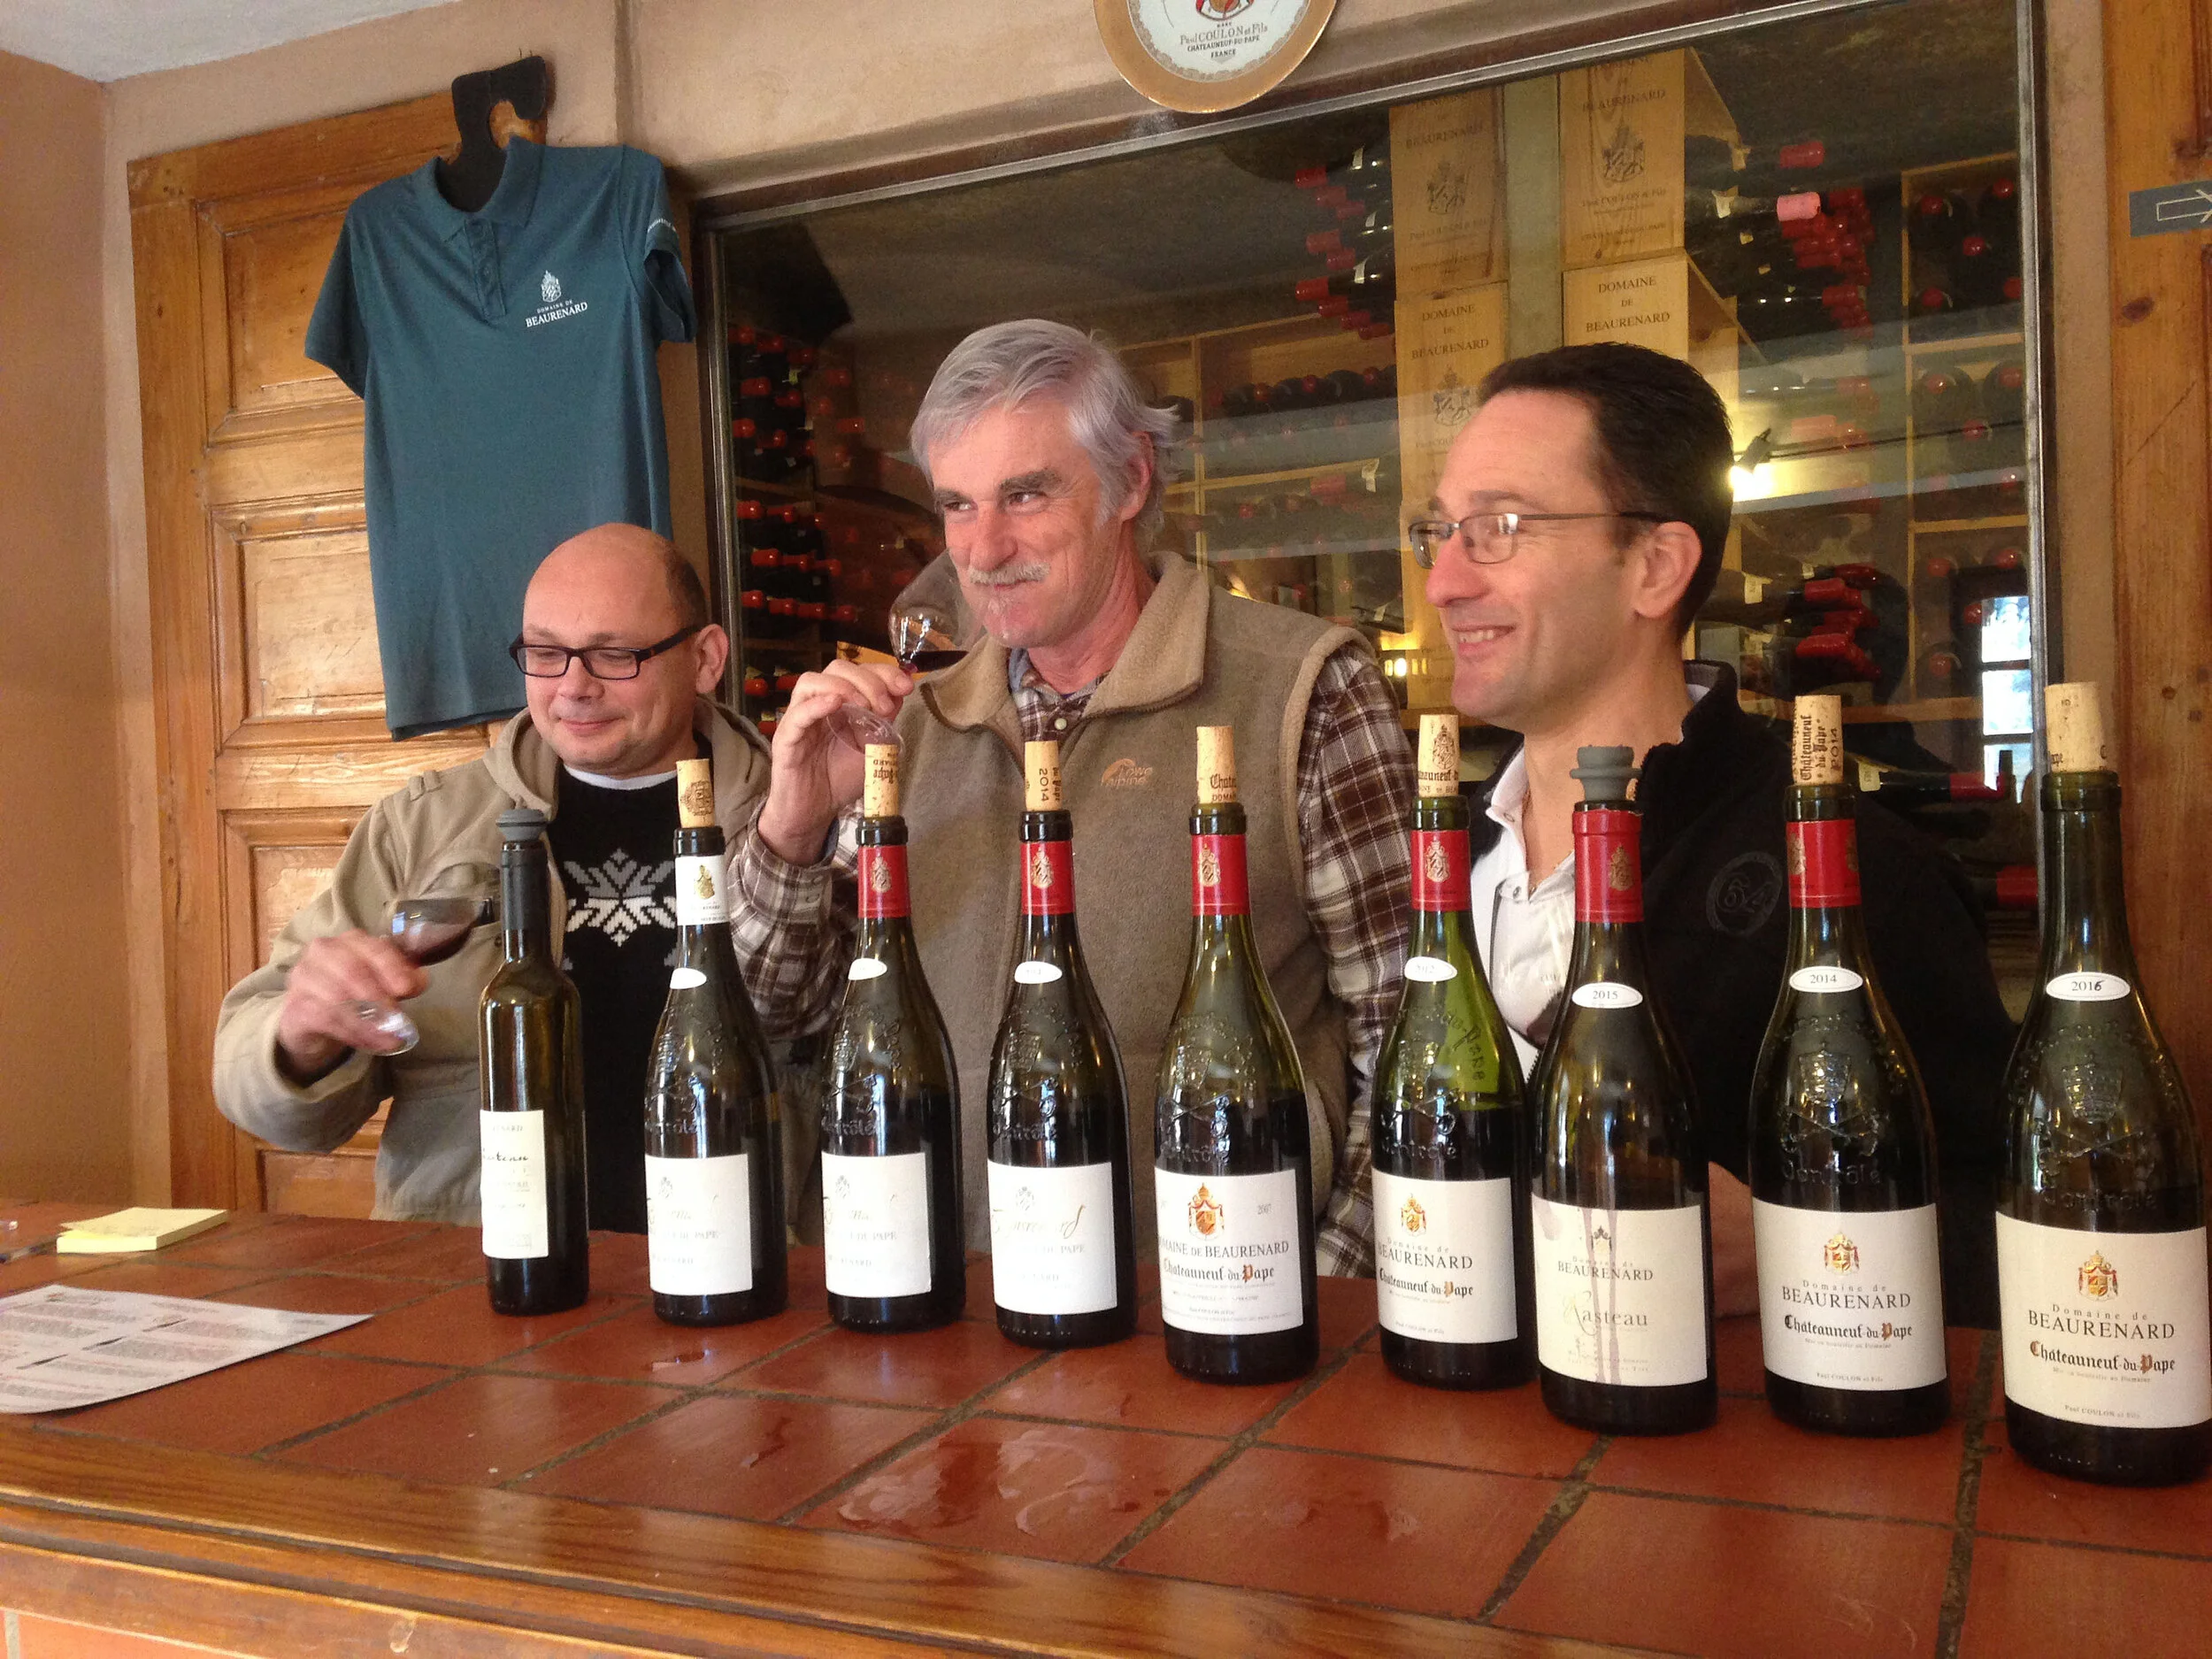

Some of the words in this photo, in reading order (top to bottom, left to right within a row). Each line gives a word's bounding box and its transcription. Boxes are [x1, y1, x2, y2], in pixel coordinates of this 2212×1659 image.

[1180, 33, 1197, 45] Paul
[1198, 25, 1243, 42] COULON
[1252, 22, 1268, 35] Fils
[1210, 49, 1237, 58] FRANCE
[1598, 276, 1657, 294] DOMAINE
[537, 303, 564, 313] DOMAINE
[1422, 303, 1476, 321] DOMAINE
[1621, 299, 1633, 308] DE
[525, 301, 588, 327] BEAURENARD
[1586, 311, 1671, 333] BEAURENARD
[1410, 339, 1489, 360] BEAURENARD
[1039, 768, 1049, 802] 2014
[1810, 974, 1837, 984] 2014
[2071, 979, 2106, 992] 2016
[1593, 990, 1618, 1000] 2015
[1191, 1246, 1202, 1256] DE
[1205, 1240, 1289, 1257] BEAURENARD
[1378, 1242, 1472, 1269] BEAURENARD
[1558, 1260, 1653, 1281] BEAURENARD
[1803, 1280, 1863, 1292] Domaine
[1782, 1286, 1911, 1310] BEAURENARD
[2052, 1304, 2120, 1319] Domaine
[2132, 1311, 2147, 1321] de
[2028, 1310, 2175, 1340] BEAURENARD
